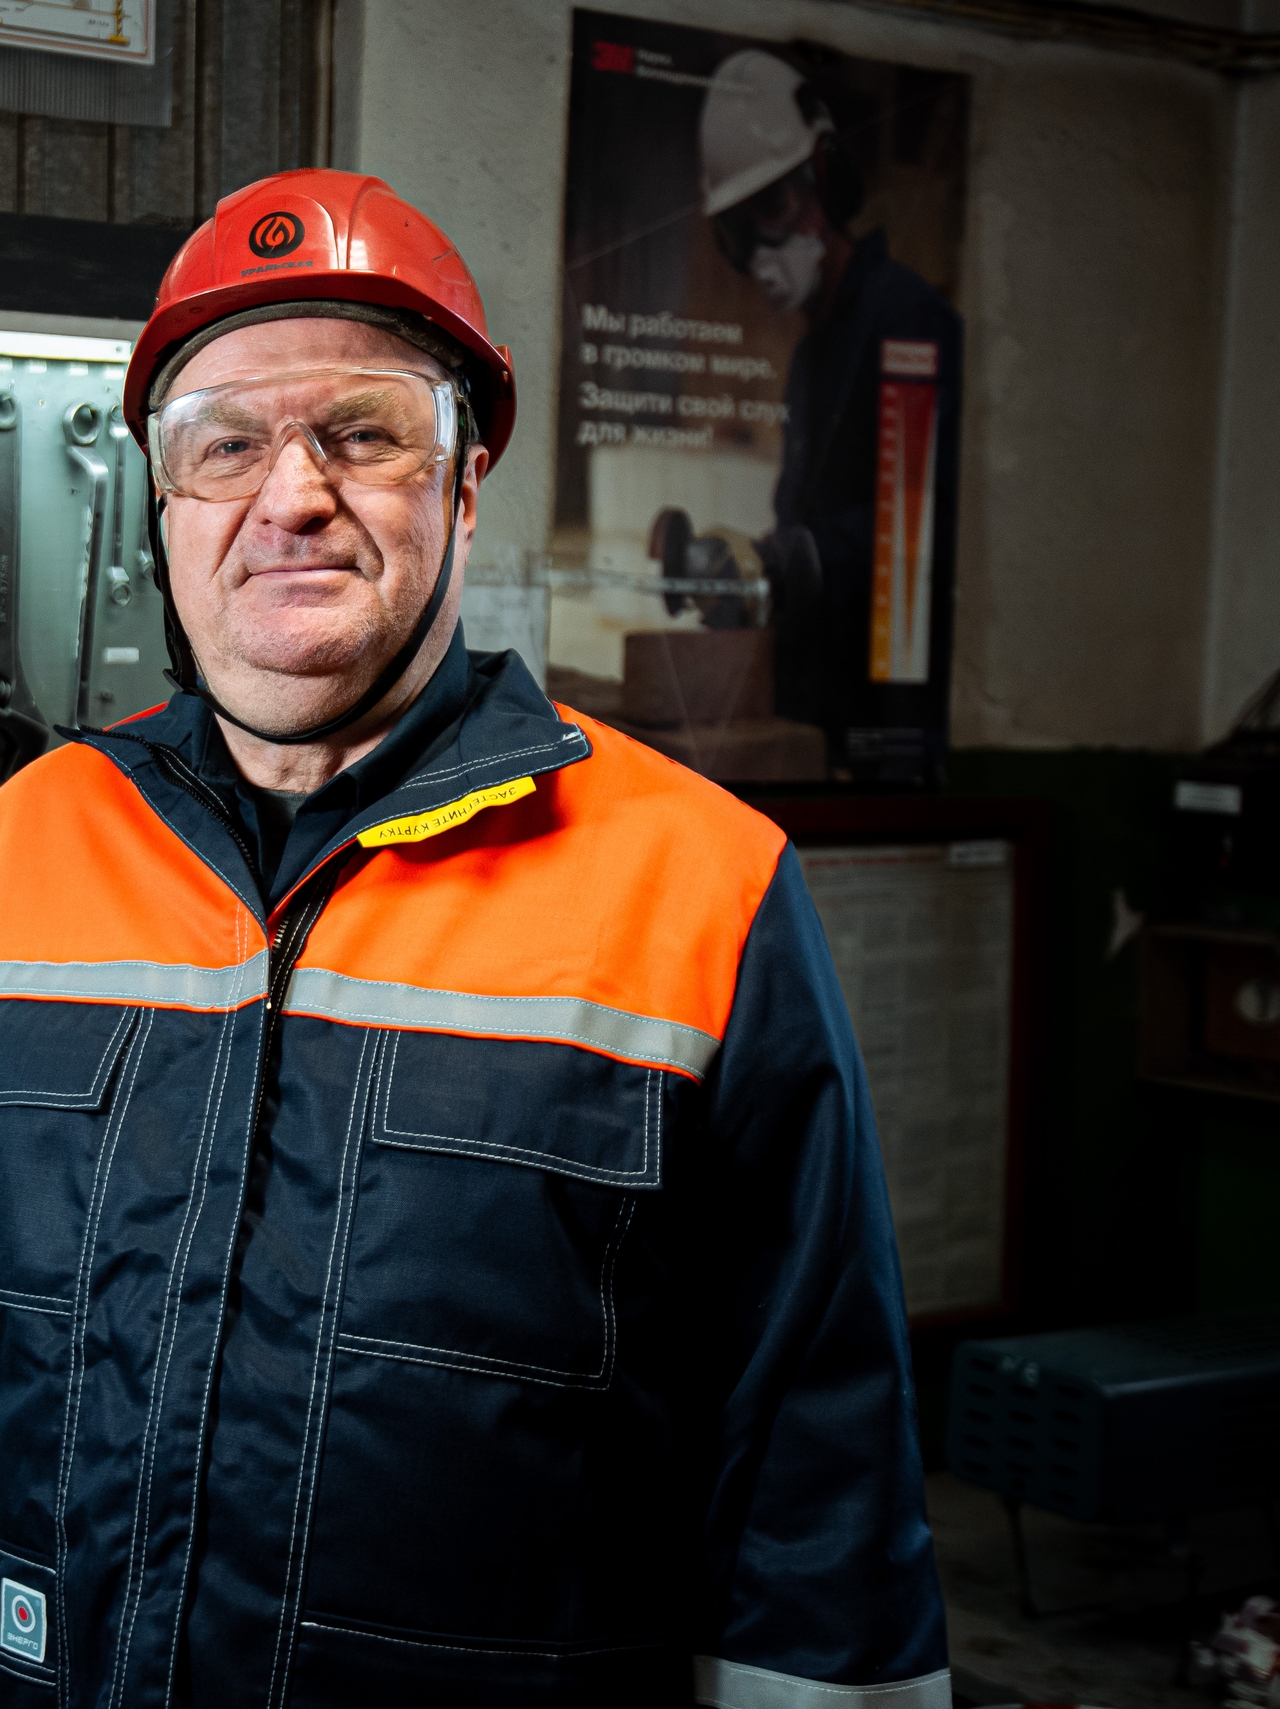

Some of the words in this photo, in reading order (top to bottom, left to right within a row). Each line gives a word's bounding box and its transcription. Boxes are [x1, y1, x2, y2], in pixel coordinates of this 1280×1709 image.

[582, 304, 625, 332] Мы
[629, 310, 743, 344] работаем
[579, 343, 598, 364] в
[602, 344, 706, 372] громком
[579, 381, 673, 415] Защити
[676, 393, 735, 418] свой
[739, 400, 791, 426] слух
[578, 420, 626, 445] для
[631, 425, 714, 447] жизни!
[431, 786, 518, 829] ЗАСТЕГНИТЕ
[377, 821, 430, 839] КУРТКУ
[7, 1632, 38, 1650] ЭНЕРГО
